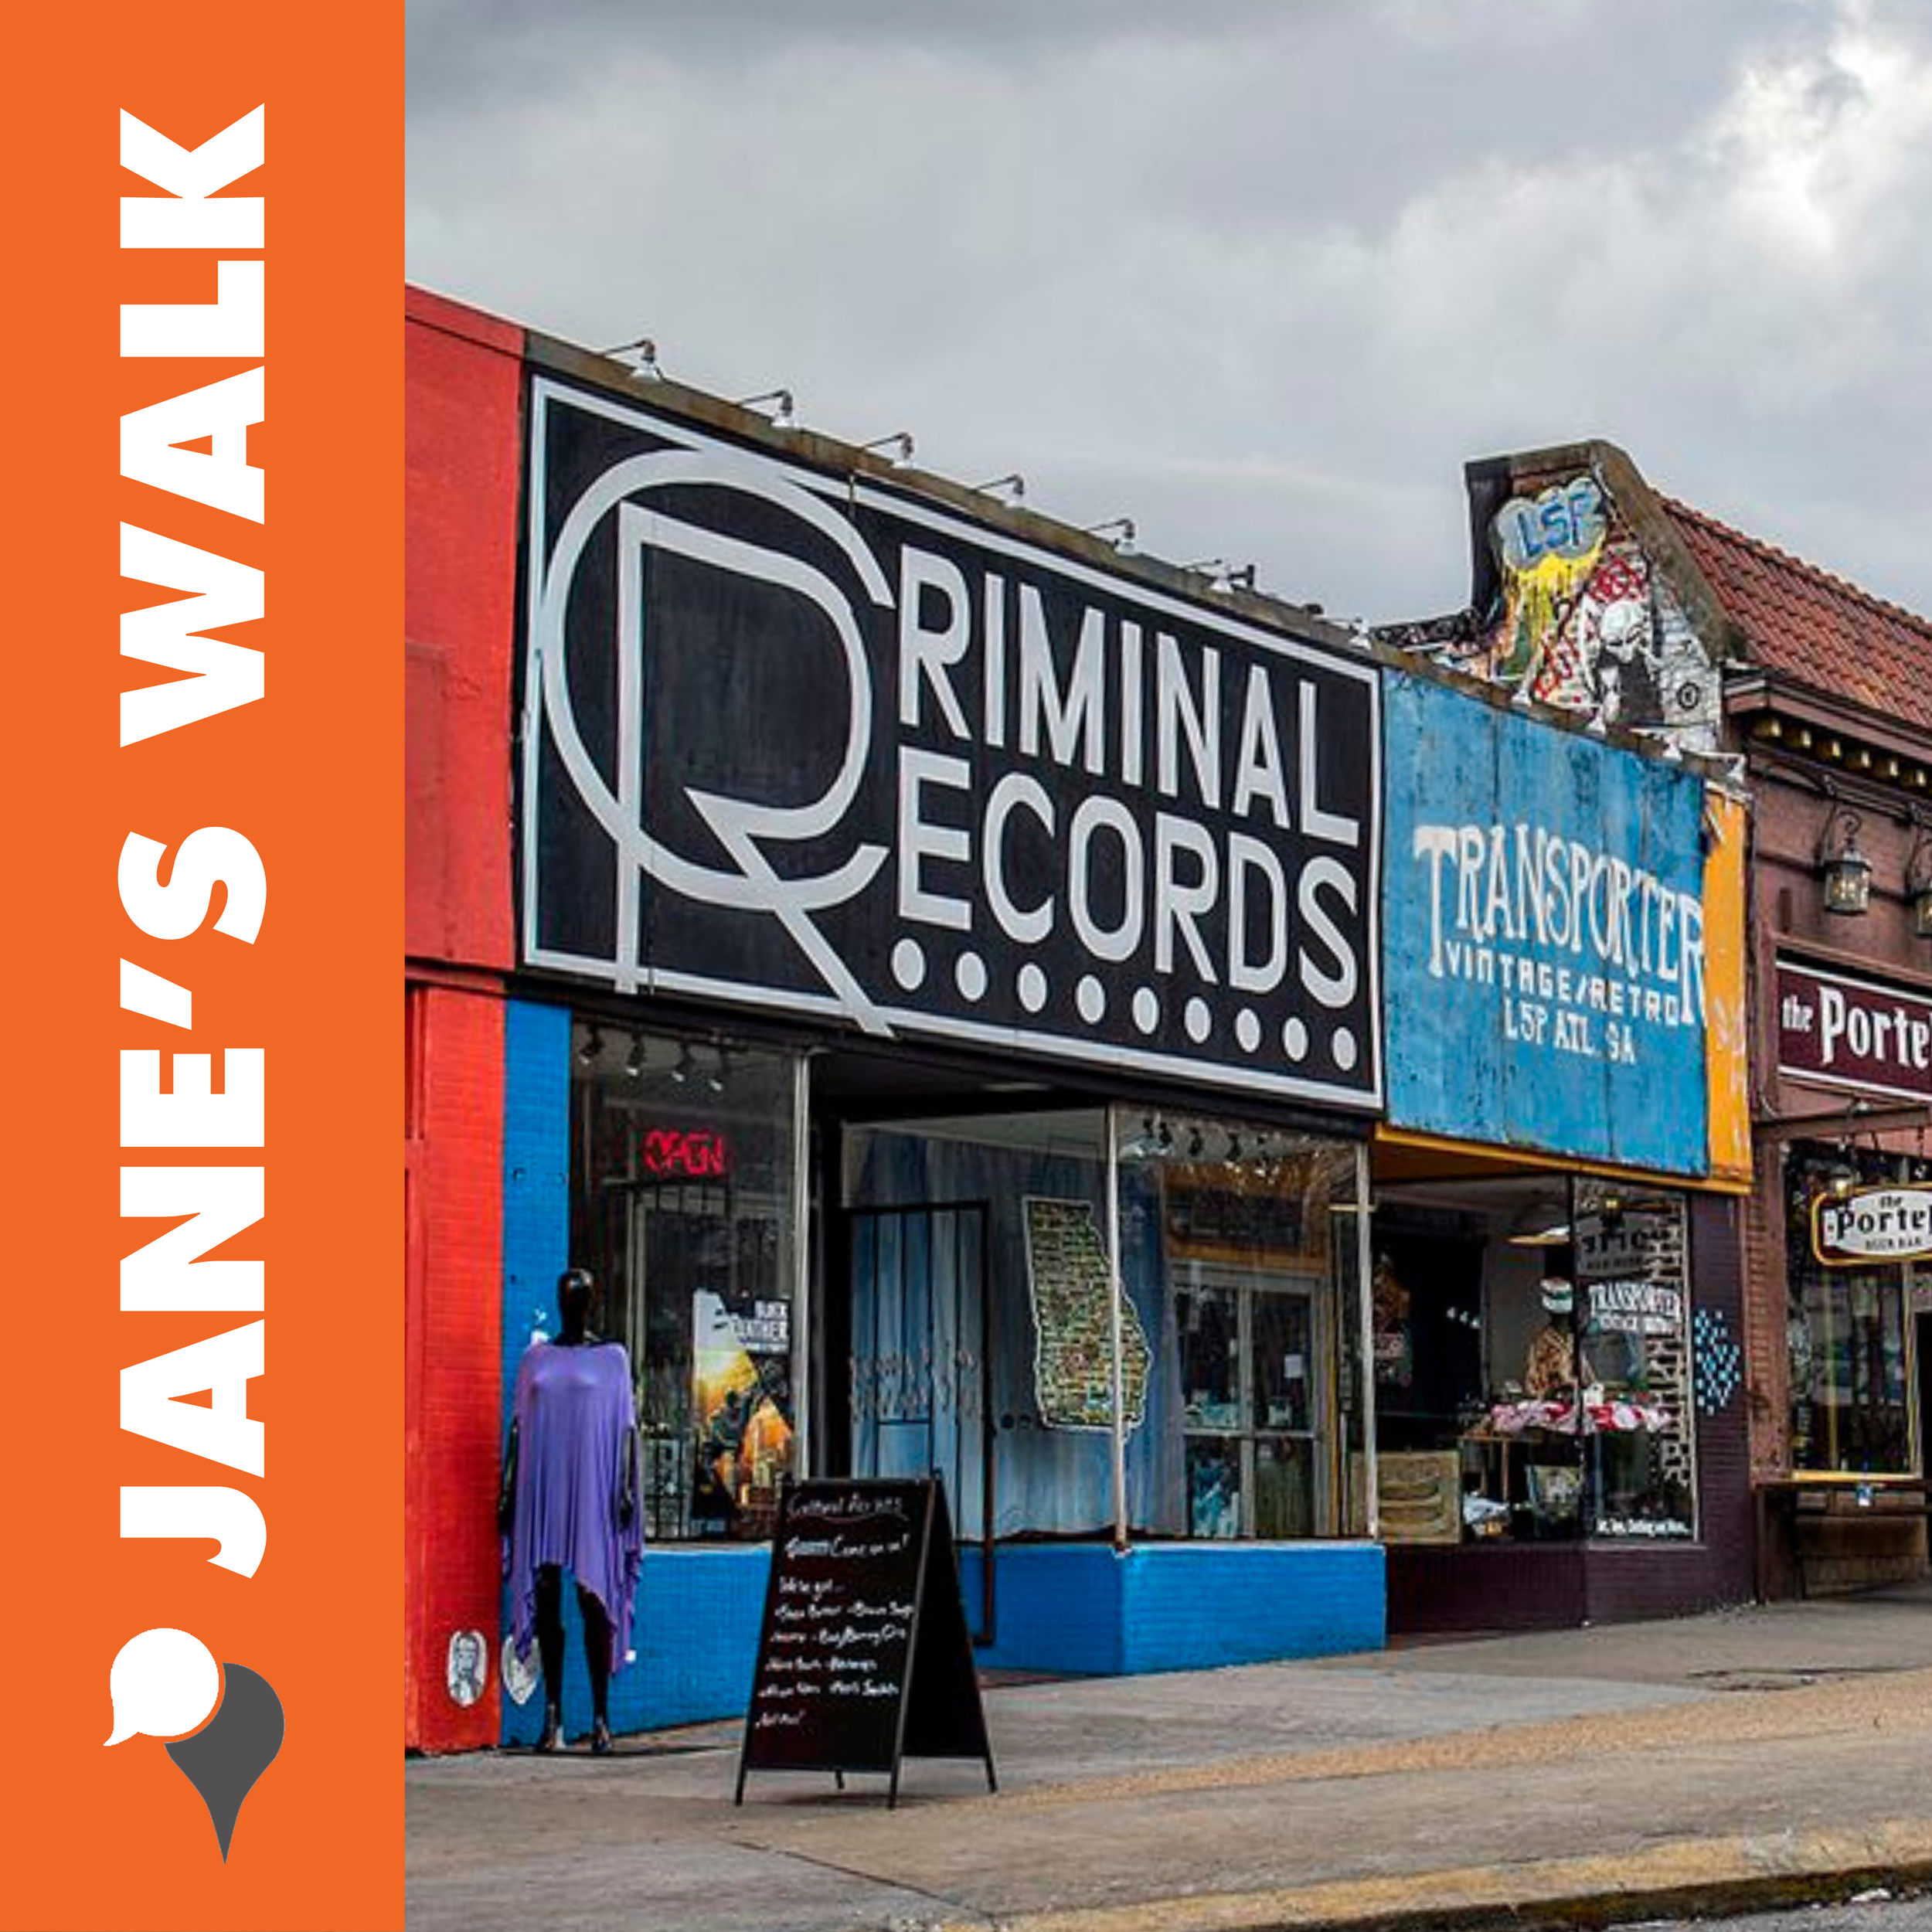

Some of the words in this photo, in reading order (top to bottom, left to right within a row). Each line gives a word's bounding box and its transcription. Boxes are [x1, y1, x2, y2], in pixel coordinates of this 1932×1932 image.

[1413, 823, 1706, 1029] TRANSPORTER
[1782, 995, 1813, 1032] the
[1818, 985, 1932, 1070] Porte
